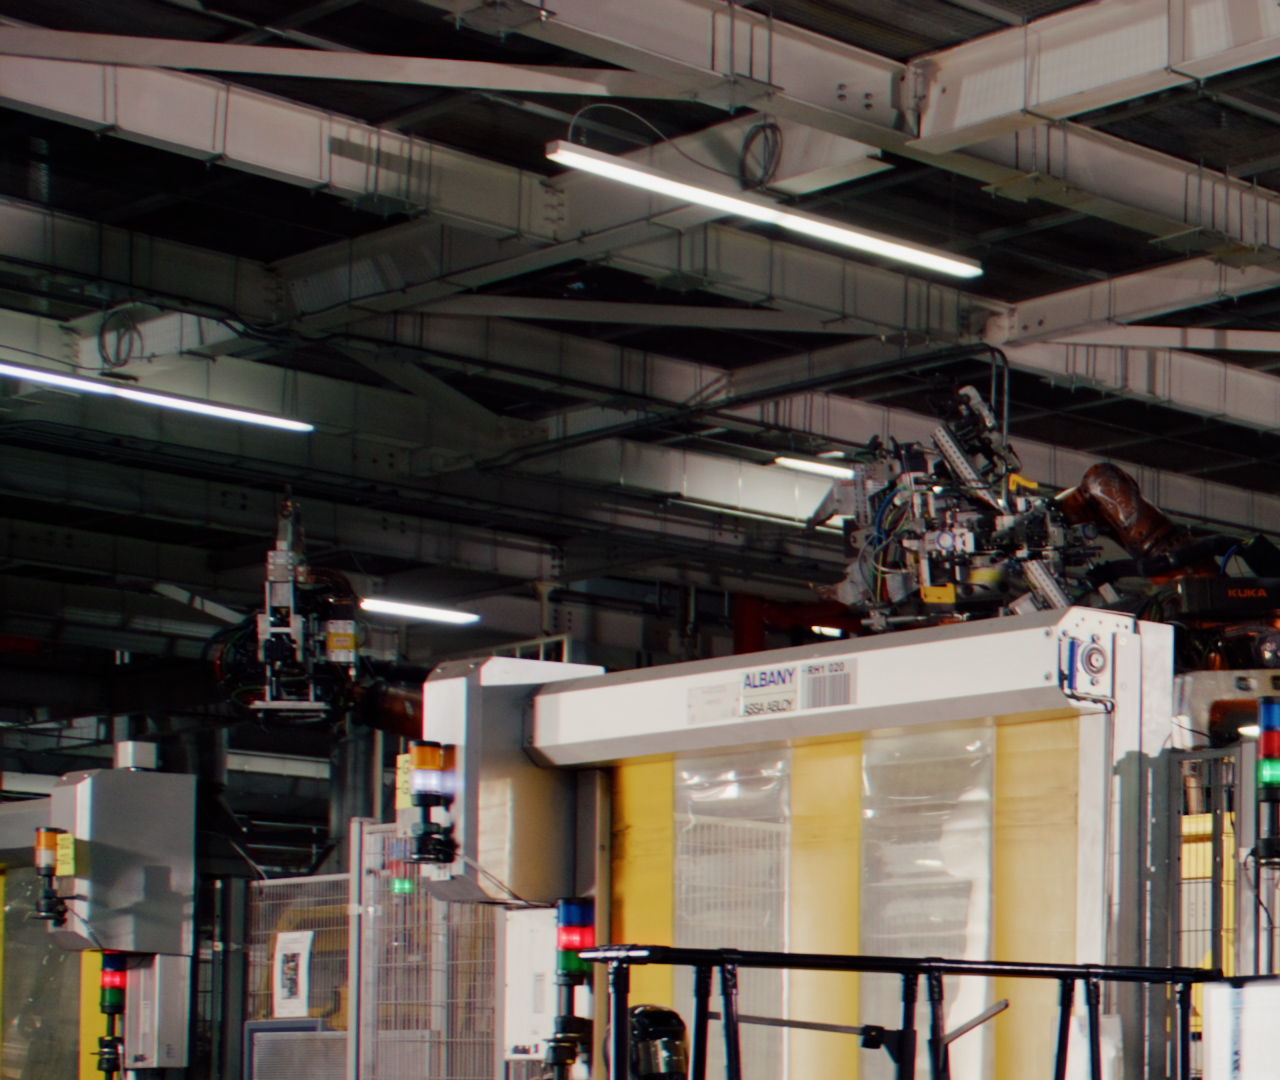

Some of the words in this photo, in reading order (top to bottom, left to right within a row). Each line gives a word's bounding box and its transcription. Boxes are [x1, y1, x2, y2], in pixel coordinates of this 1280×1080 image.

[1227, 588, 1268, 598] KUKA
[743, 667, 797, 690] ALBANY
[743, 700, 765, 716] ASSA
[765, 698, 795, 714] ABLOY
